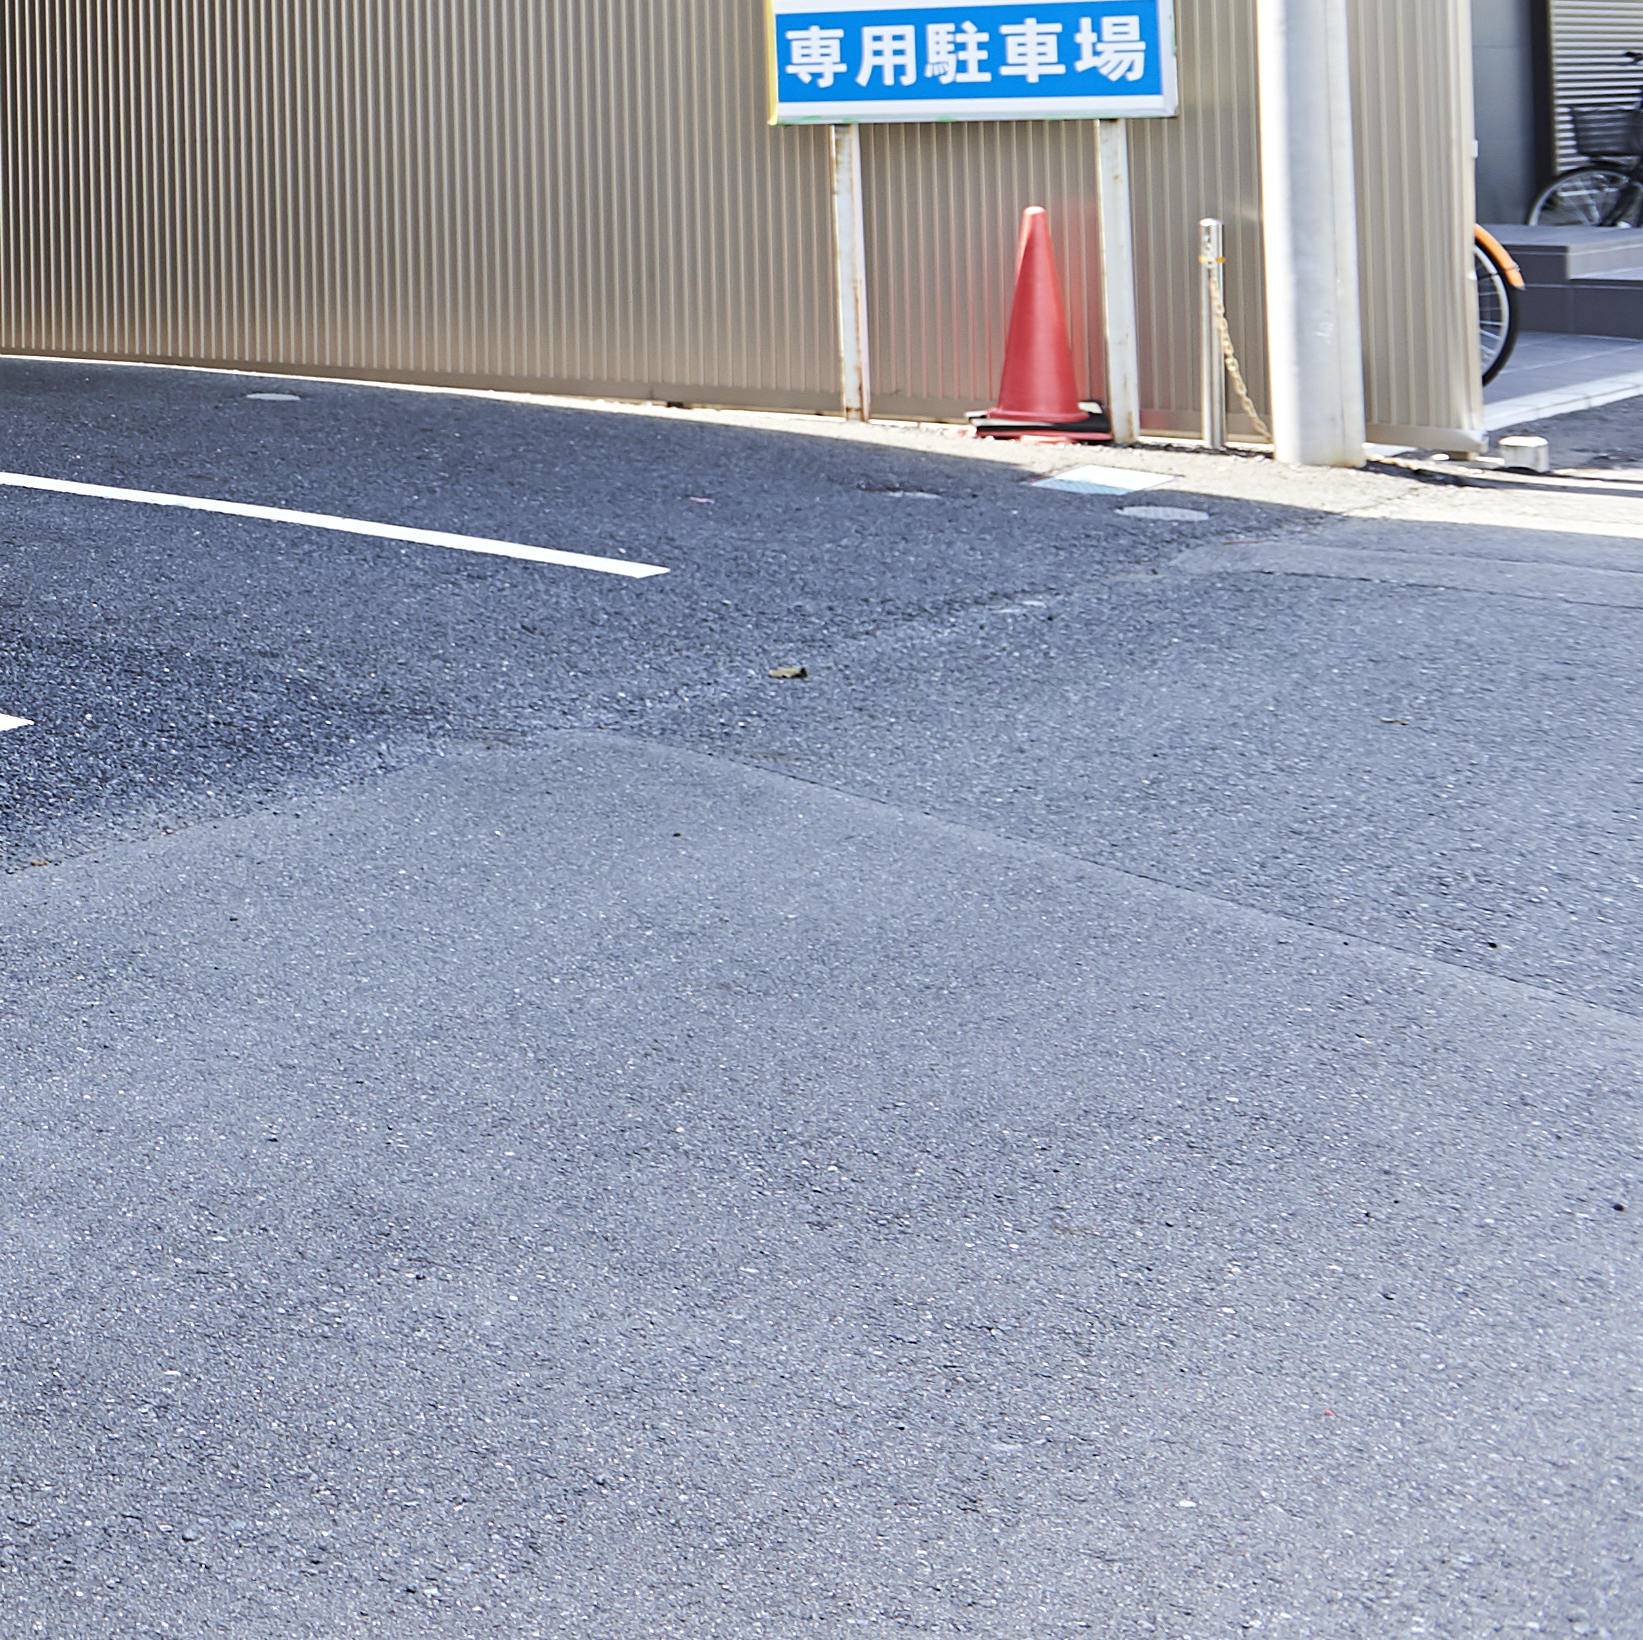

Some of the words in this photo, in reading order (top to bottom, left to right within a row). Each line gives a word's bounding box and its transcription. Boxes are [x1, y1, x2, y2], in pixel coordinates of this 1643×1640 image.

[784, 14, 1147, 89] 専用駐車場
